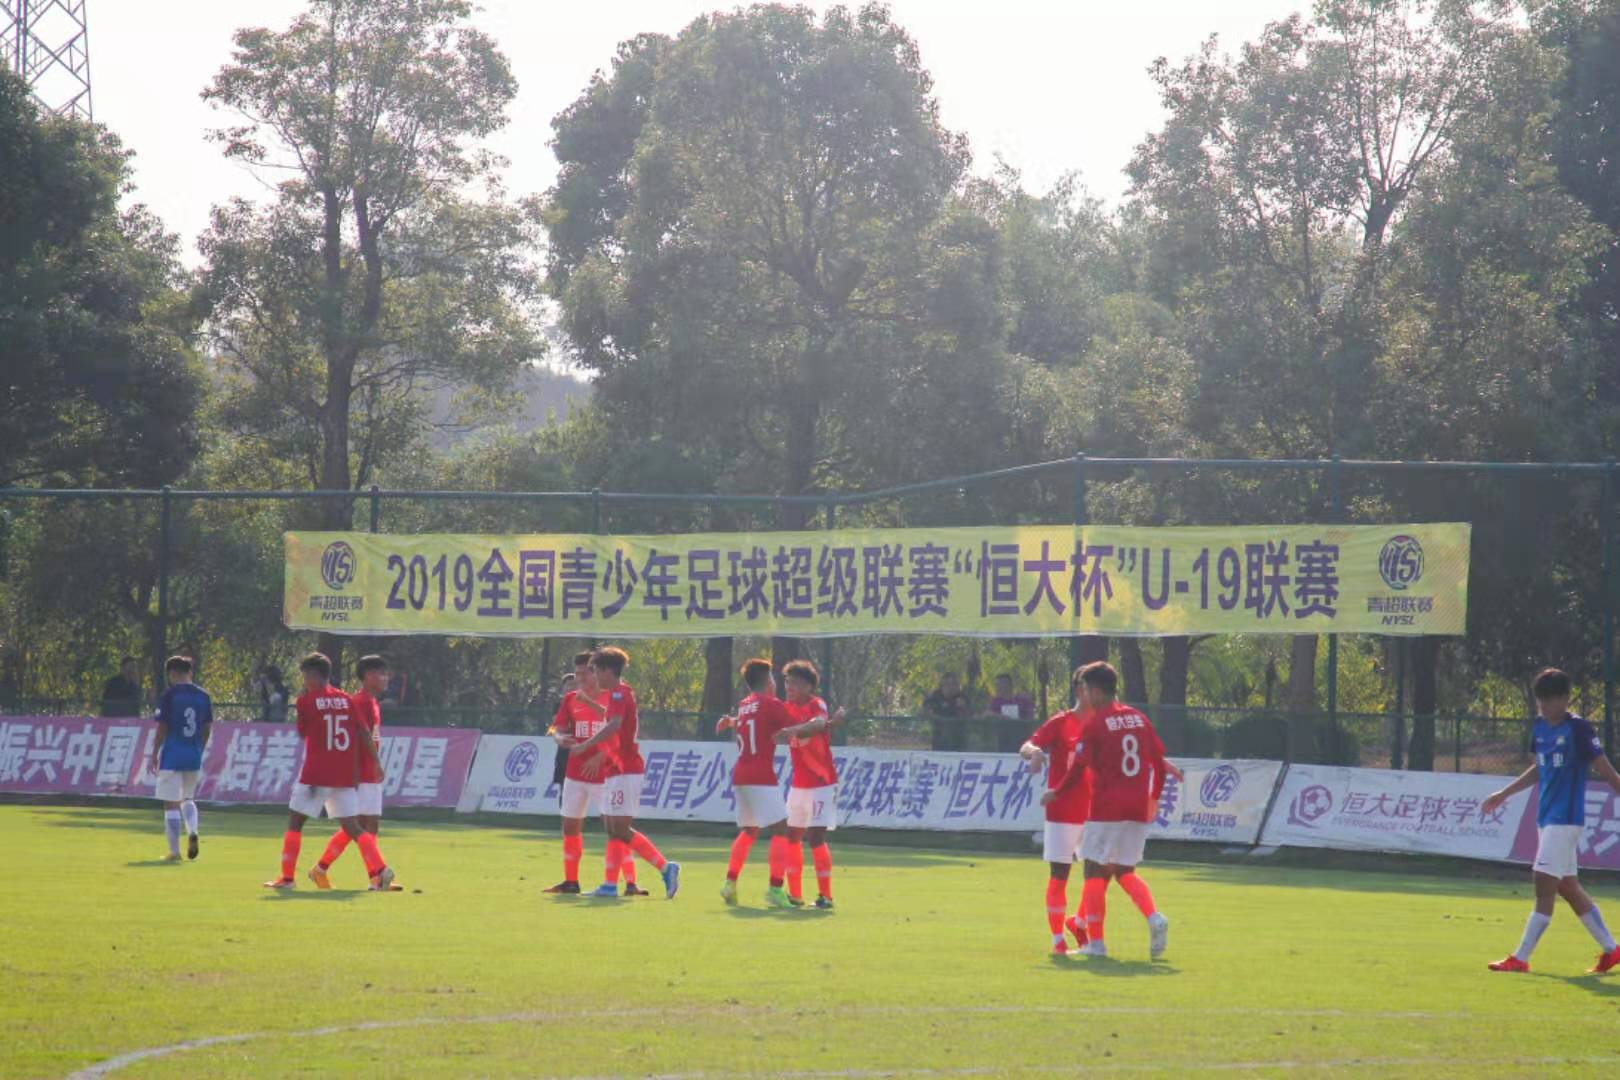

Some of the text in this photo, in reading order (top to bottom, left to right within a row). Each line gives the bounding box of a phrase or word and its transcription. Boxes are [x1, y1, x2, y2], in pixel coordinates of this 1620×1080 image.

[184, 707, 197, 737] 3
[323, 714, 350, 751] 15
[1121, 734, 1141, 777] 8
[611, 790, 624, 805] 23
